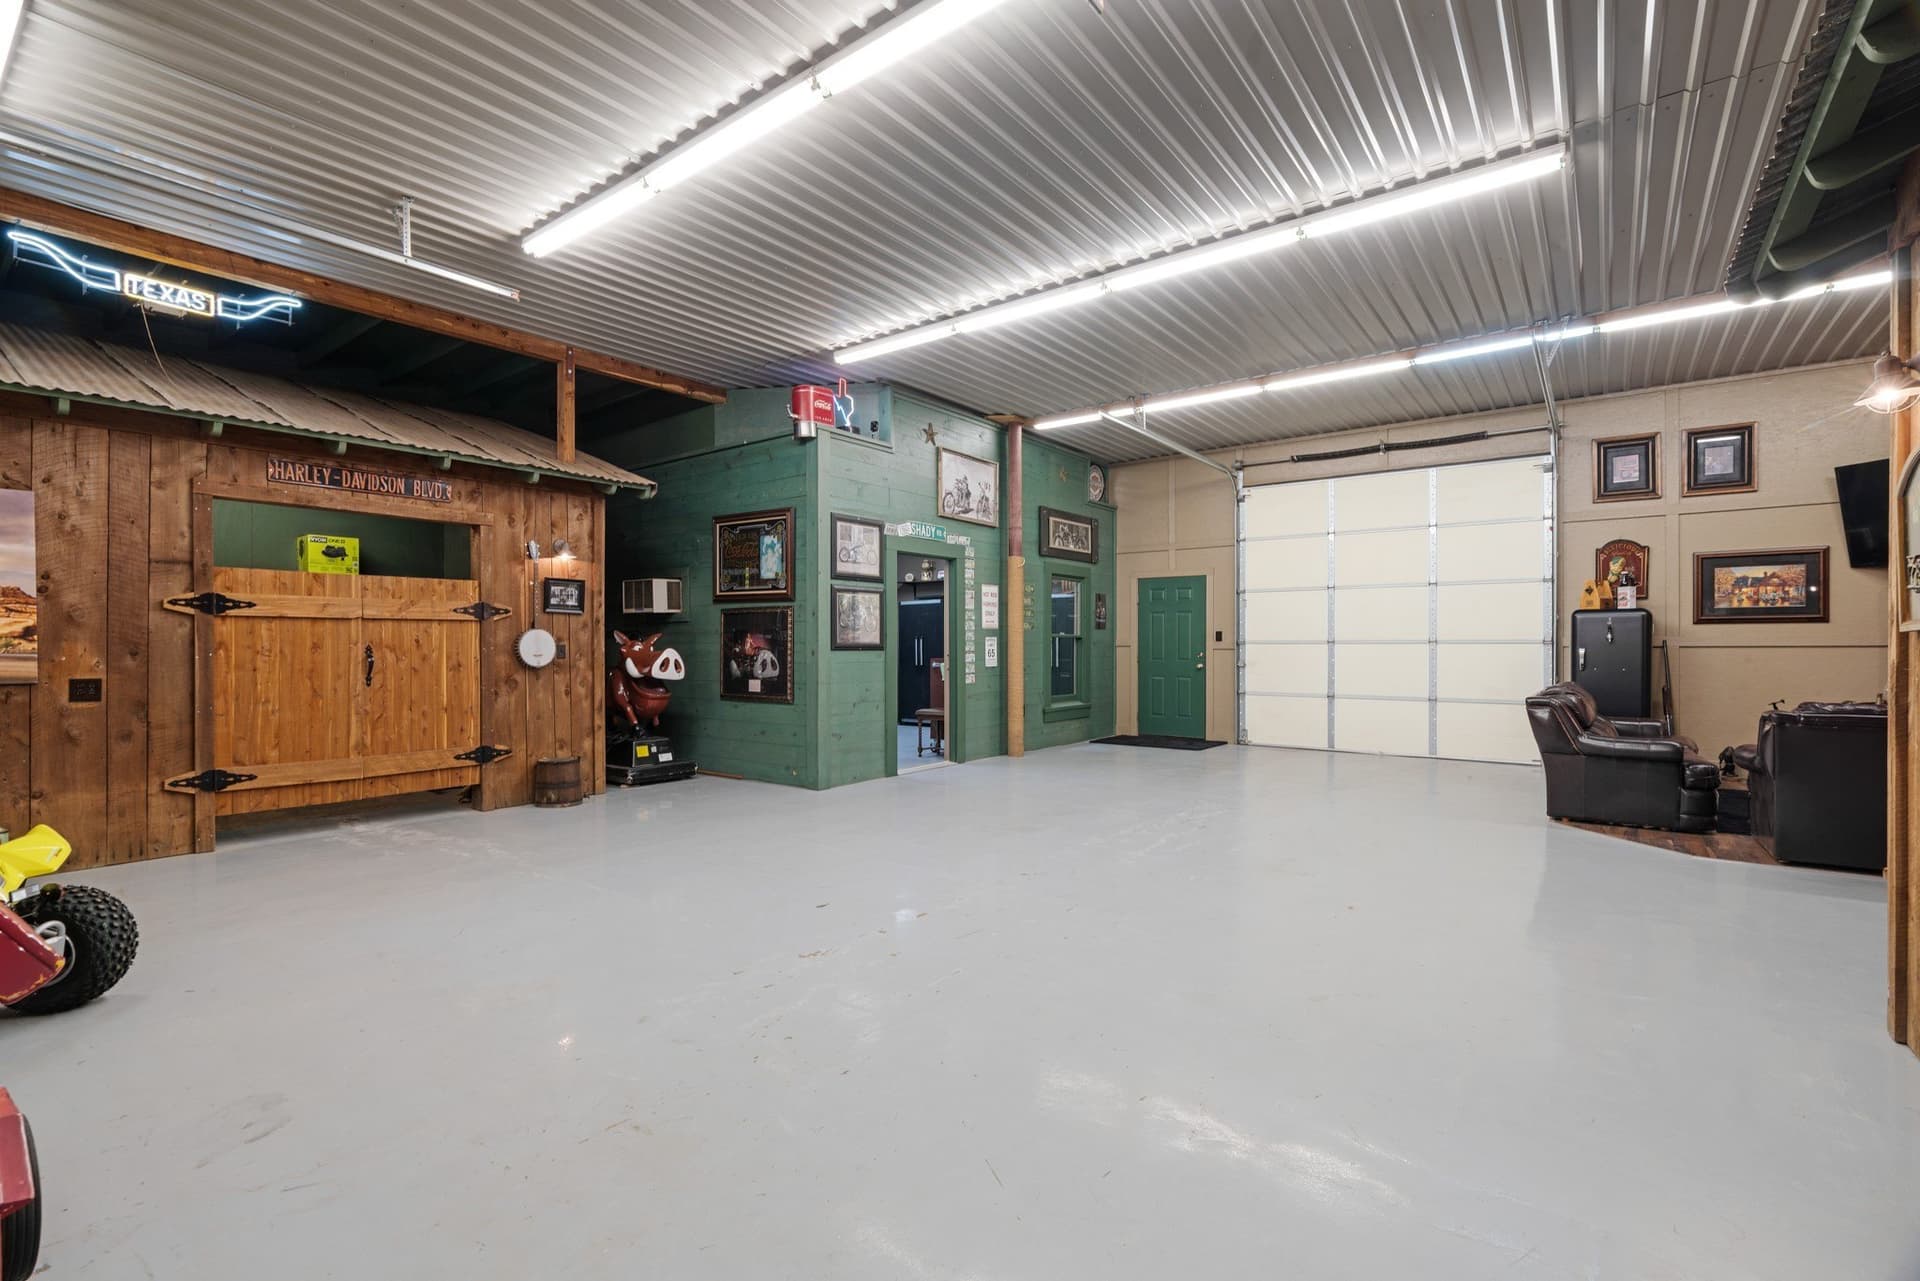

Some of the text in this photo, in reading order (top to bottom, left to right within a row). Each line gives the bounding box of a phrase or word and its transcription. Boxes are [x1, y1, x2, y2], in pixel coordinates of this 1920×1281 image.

[130, 279, 206, 311] TEXAS
[414, 479, 446, 499] BLVD.
[911, 522, 936, 538] SHADY
[988, 649, 995, 657] 65
